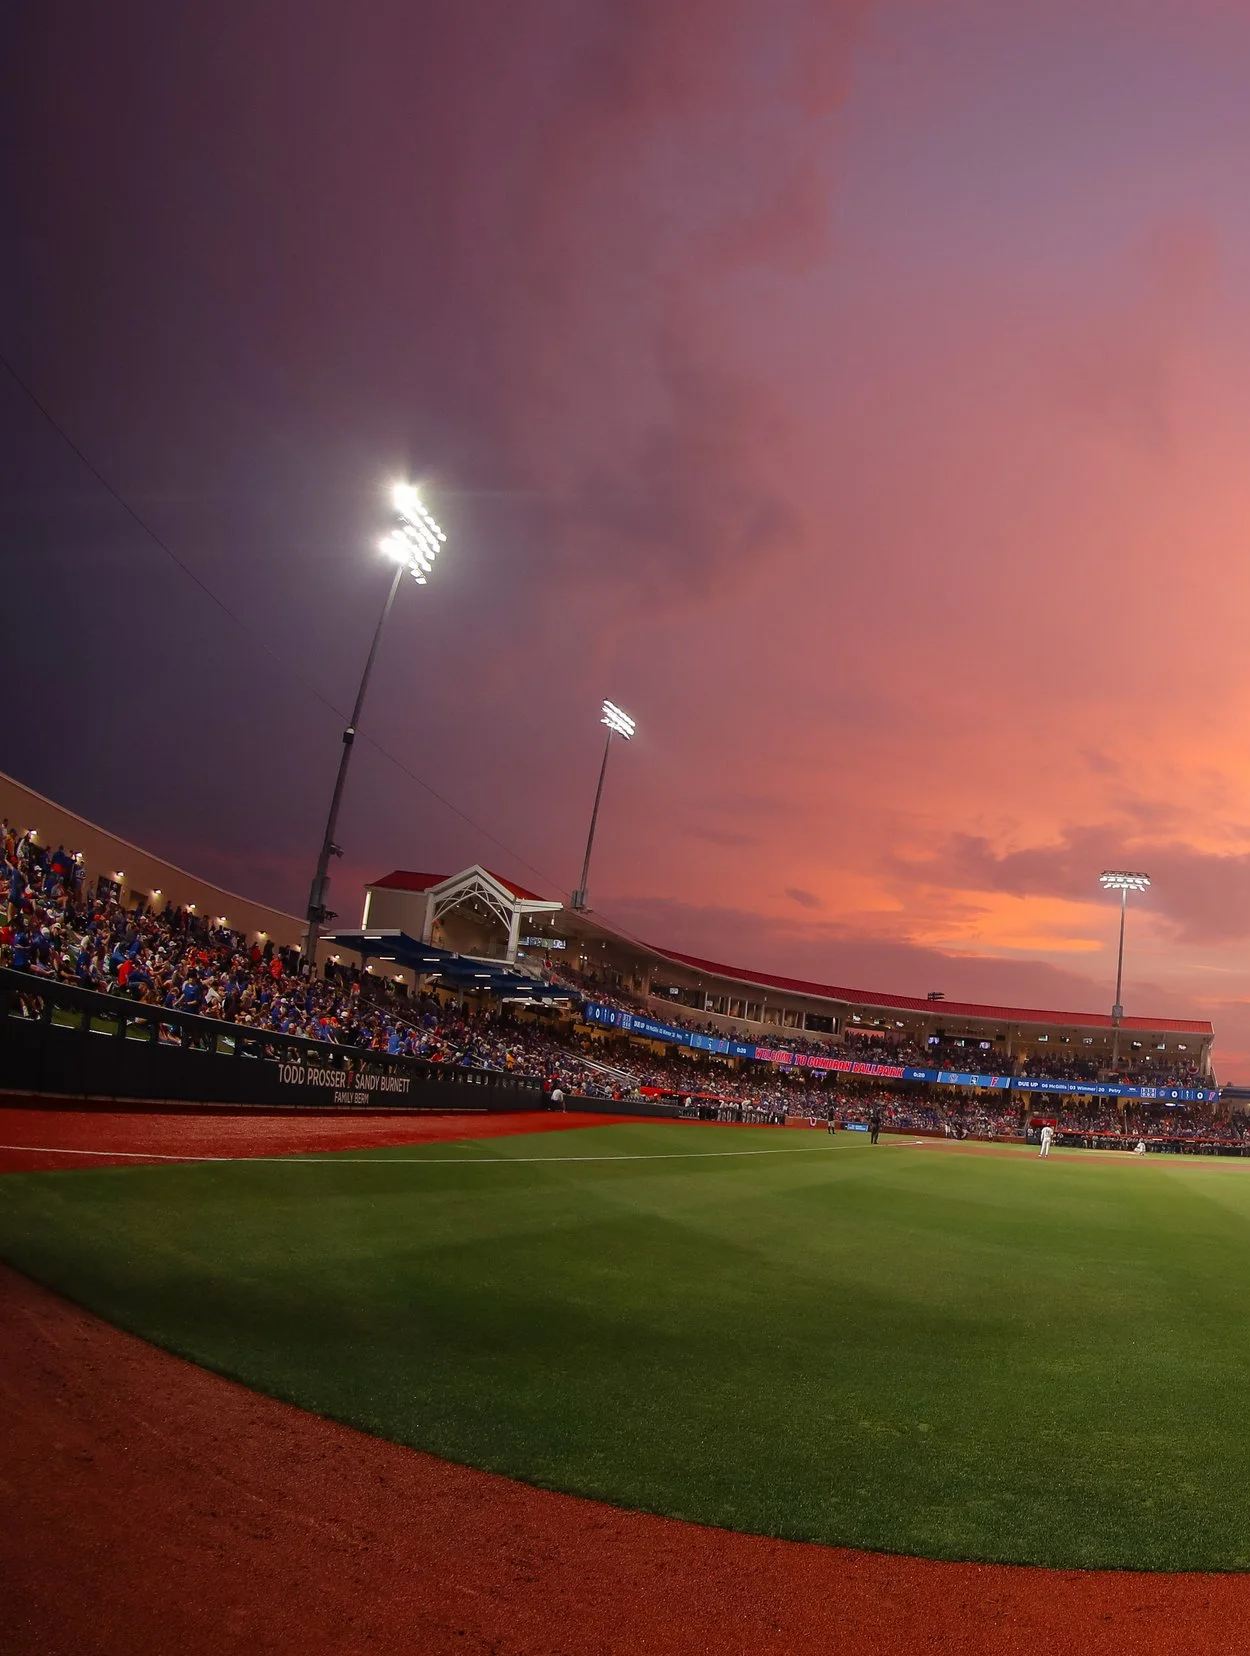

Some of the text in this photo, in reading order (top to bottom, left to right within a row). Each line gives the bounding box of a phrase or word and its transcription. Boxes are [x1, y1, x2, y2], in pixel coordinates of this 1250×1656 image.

[755, 1047, 905, 1079] WELCOME TO CONDRON BALLPARK
[278, 1064, 411, 1093] TODD PROSSER SANDY BURNETT
[334, 1091, 369, 1104] FAMILY BERM
[1171, 1090, 1178, 1098] 0
